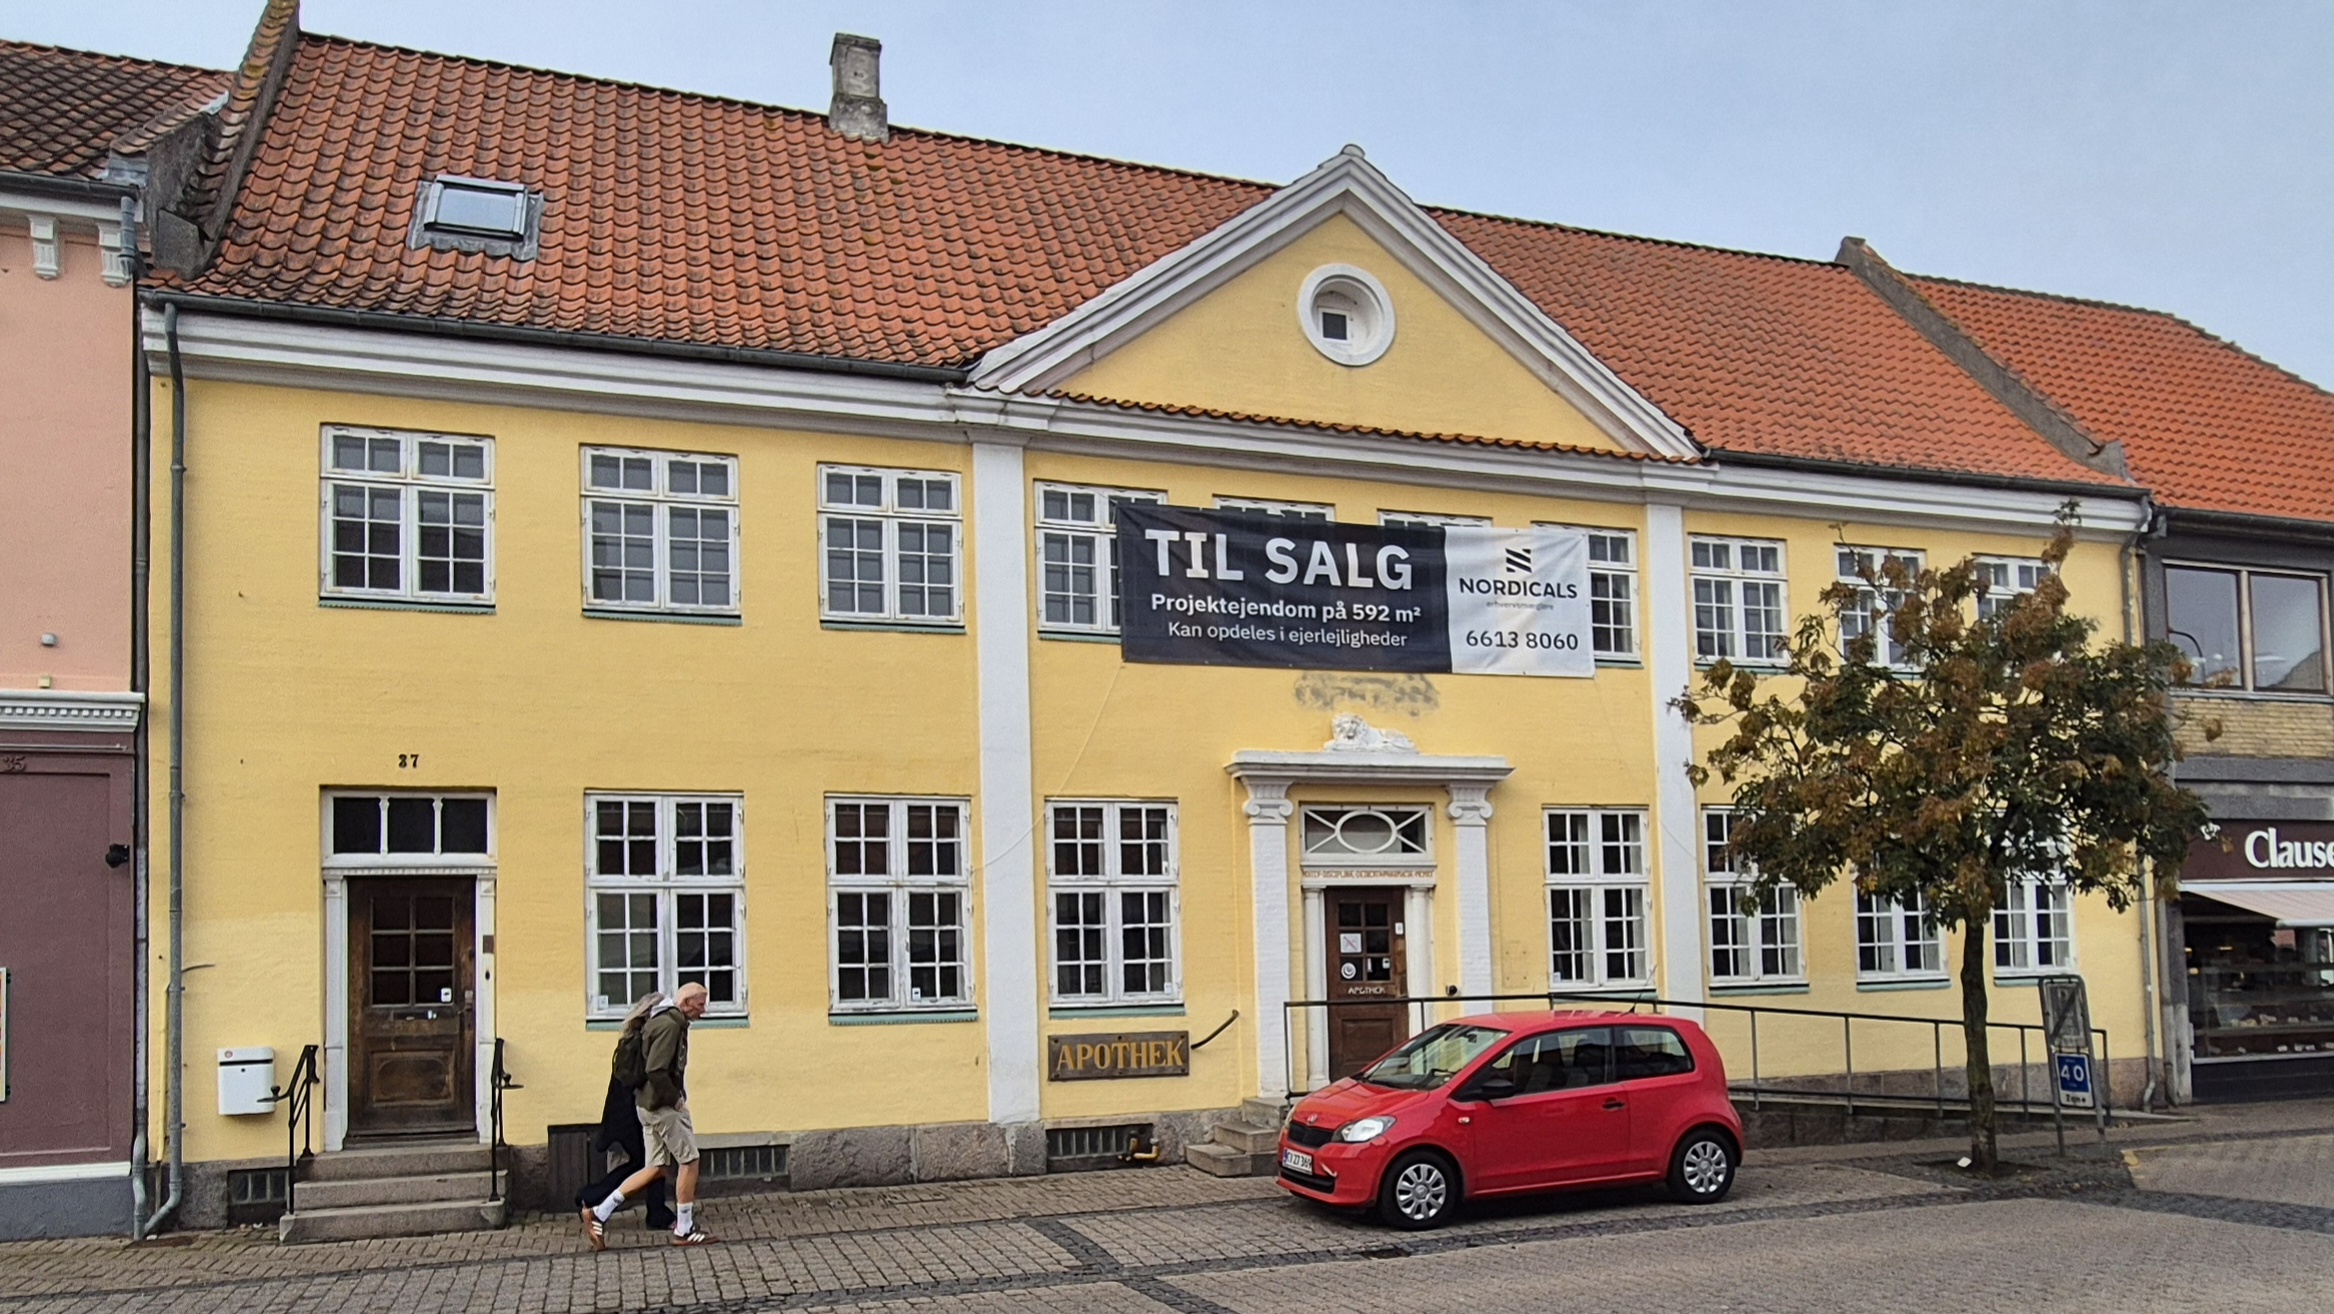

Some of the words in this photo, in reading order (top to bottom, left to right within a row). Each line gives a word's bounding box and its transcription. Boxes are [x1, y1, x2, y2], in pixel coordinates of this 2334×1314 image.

[1145, 529, 1243, 580] TIL
[1265, 537, 1412, 590] SALG
[1459, 578, 1577, 598] NORDICALS
[1152, 593, 1316, 619] Projektejendom
[1322, 601, 1347, 623] på
[1352, 603, 1391, 622] 592
[1395, 607, 1421, 622] m²
[1168, 621, 1202, 637] Kan
[1207, 624, 1276, 641] opdeles
[1280, 626, 1285, 641] i
[1289, 627, 1408, 648] ejerlejligheder
[1466, 630, 1519, 648] 6613
[1526, 632, 1578, 650] 8060
[1056, 1040, 1183, 1070] APOTHEK
[2061, 1065, 2084, 1082] 40
